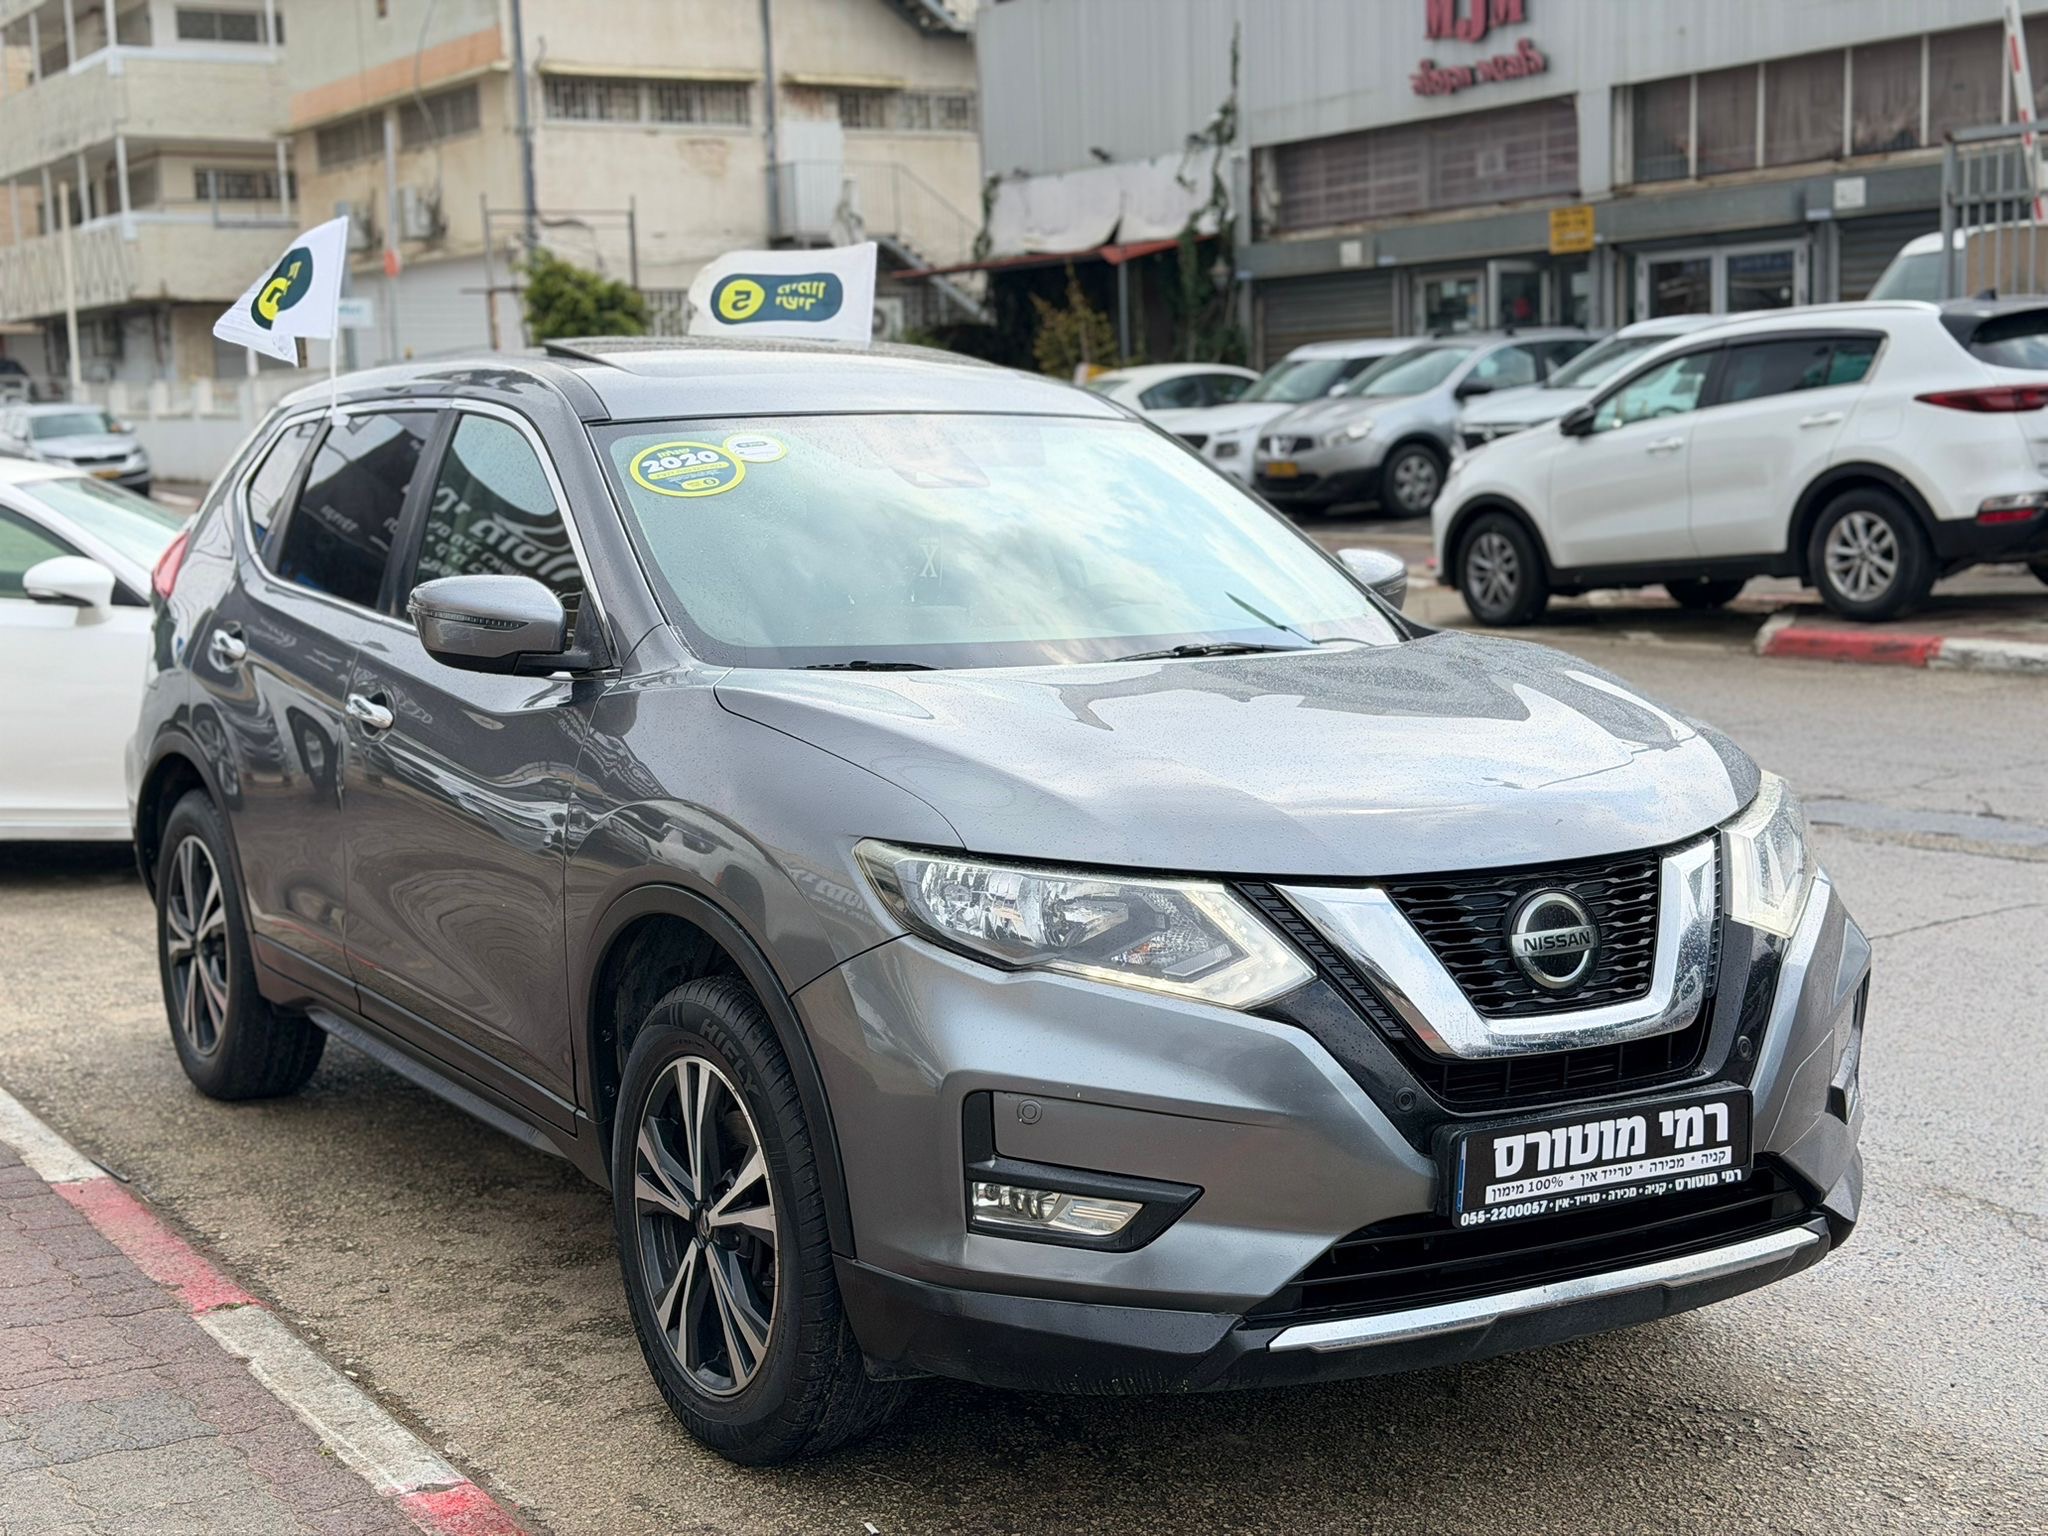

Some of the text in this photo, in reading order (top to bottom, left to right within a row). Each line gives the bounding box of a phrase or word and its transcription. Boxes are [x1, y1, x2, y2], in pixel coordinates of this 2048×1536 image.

[641, 450, 720, 474] 2020
[1523, 931, 1590, 952] NISSAN
[700, 1018, 763, 1097] HIFLY
[1493, 1102, 1729, 1179] רמי מוטורס
[1491, 1151, 1726, 1202] קניה מכירה טרייד אין 100% מימון
[1675, 1173, 1718, 1191] מוטורס
[1721, 1169, 1742, 1183] רמי
[1608, 1187, 1637, 1201] מכירה
[1645, 1182, 1667, 1195] קניה
[1460, 1200, 1548, 1227] 055-2200057
